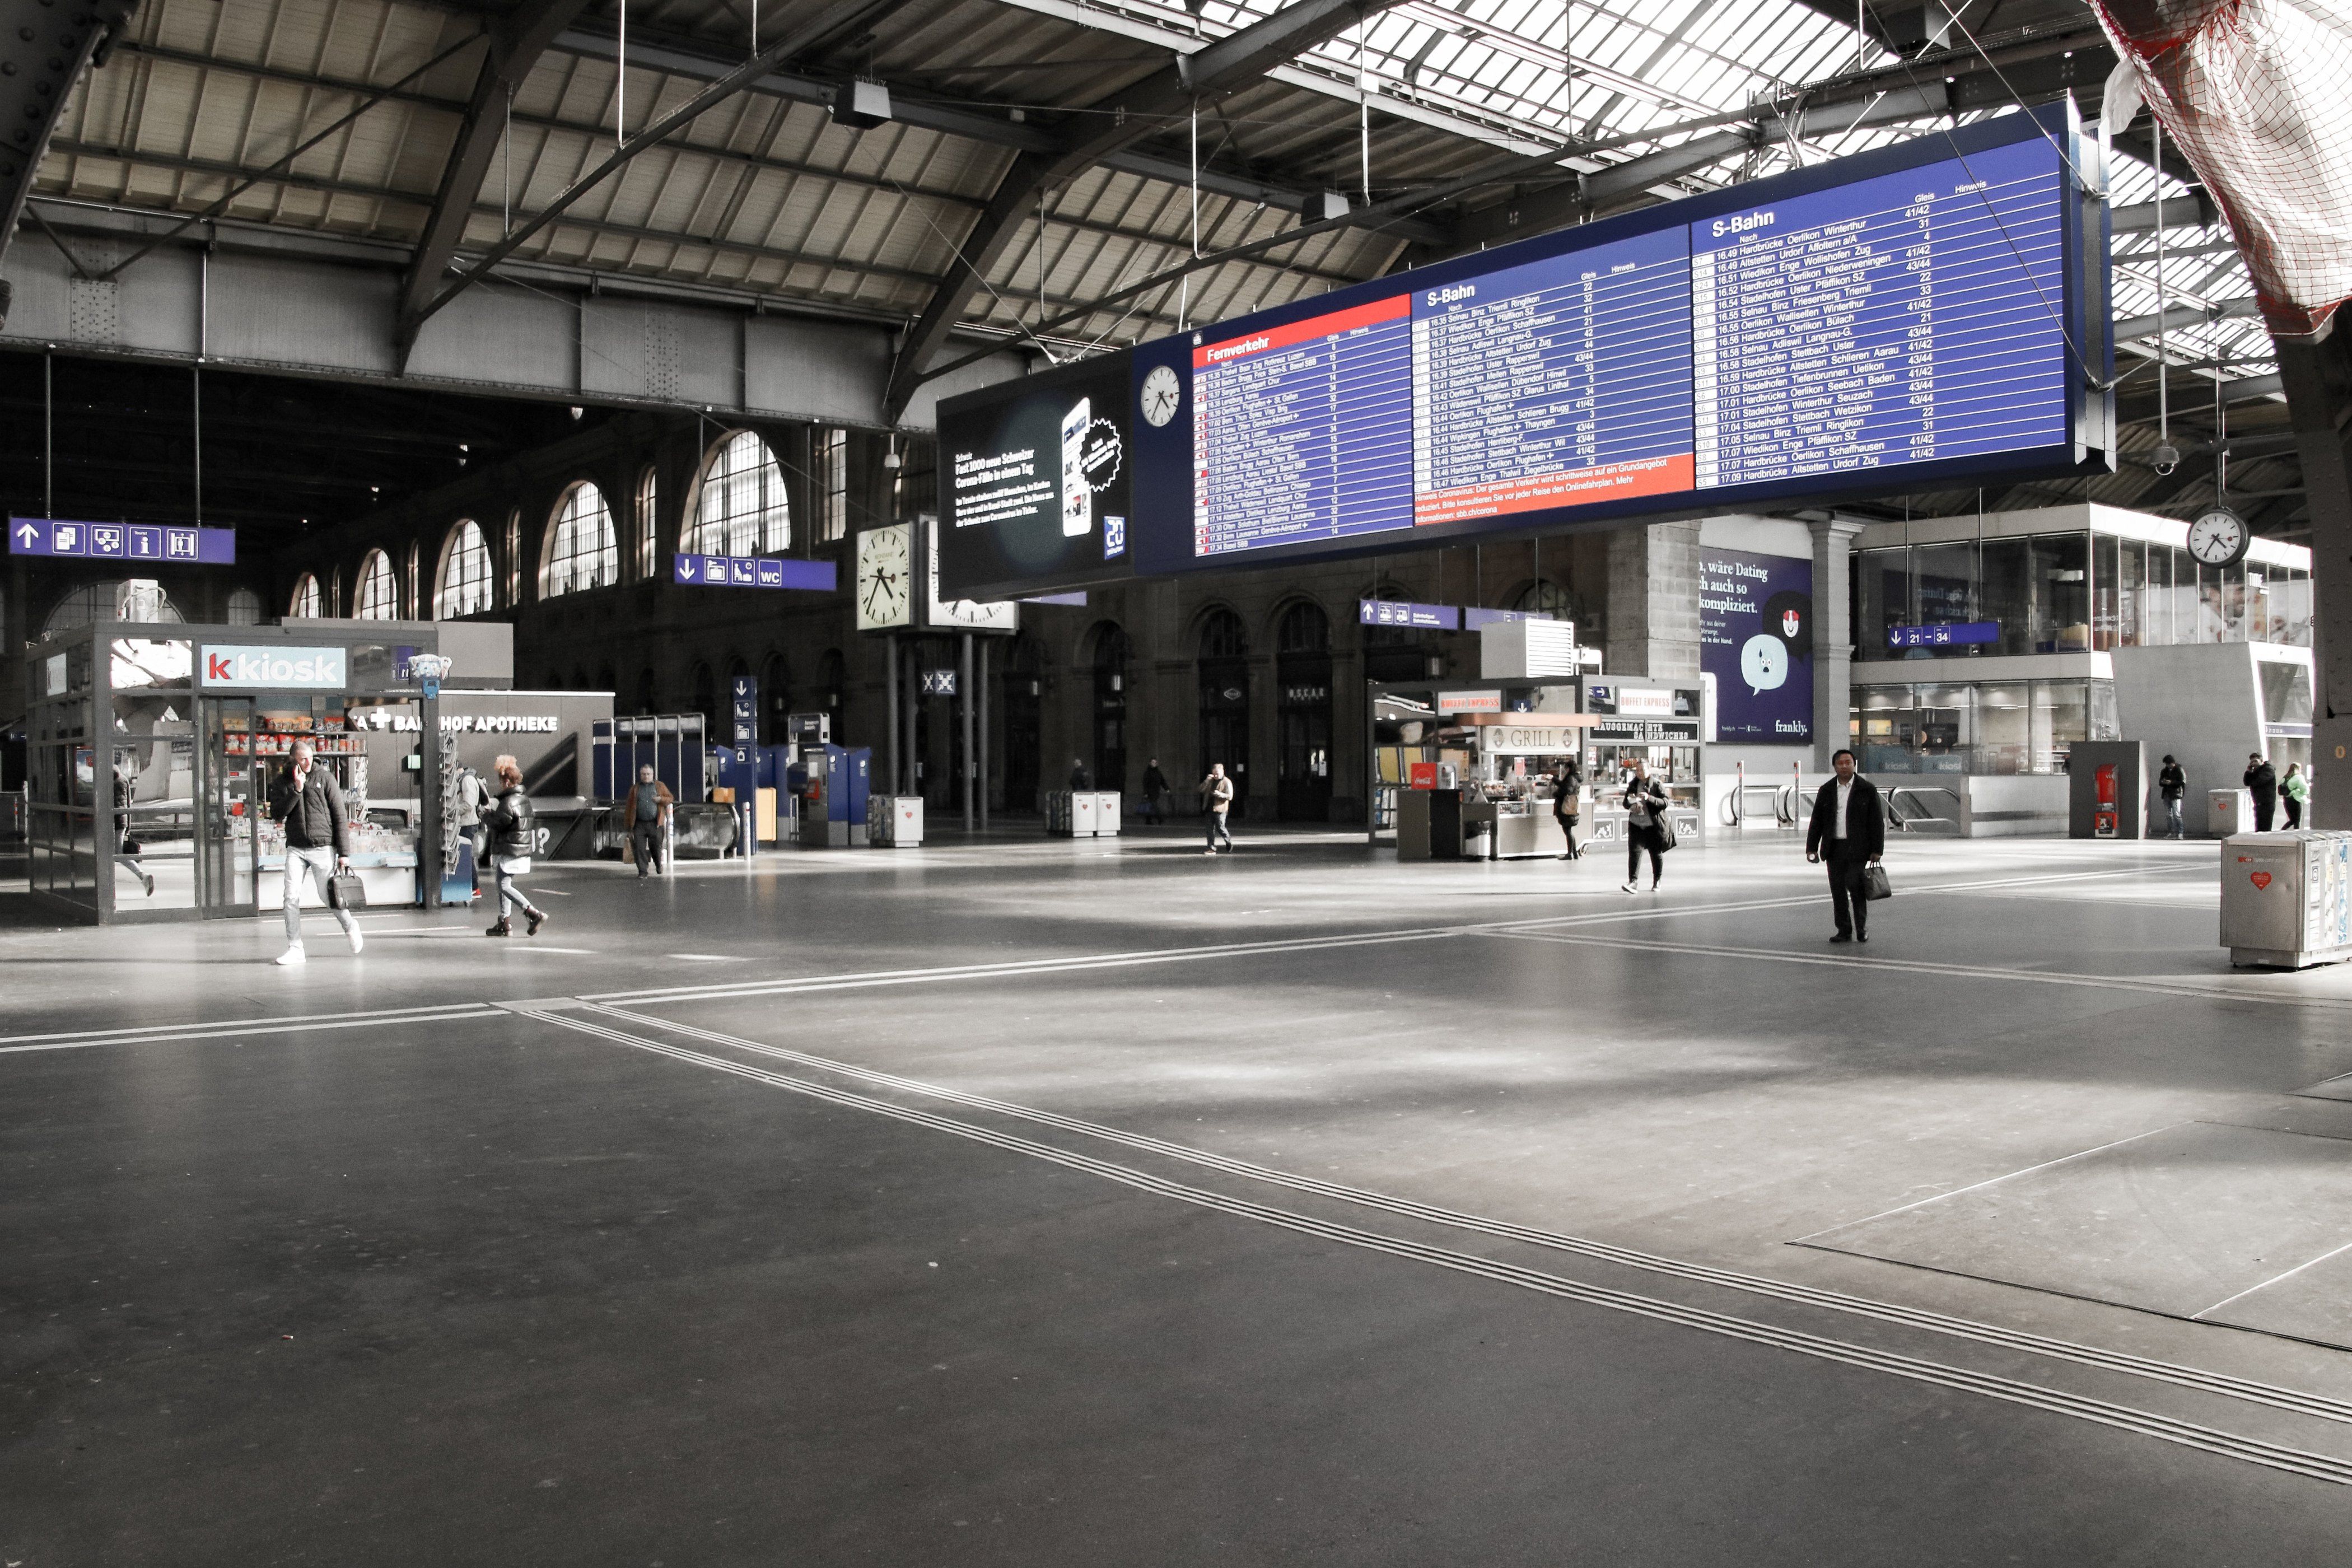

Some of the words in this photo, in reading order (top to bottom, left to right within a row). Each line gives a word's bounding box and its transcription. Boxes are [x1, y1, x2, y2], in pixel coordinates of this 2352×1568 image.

[1914, 192, 1935, 203] Gleis
[1954, 180, 1987, 194] Hinweis
[1712, 211, 1775, 237] S-Bahn
[1716, 248, 1738, 260] 16.49
[1739, 239, 1784, 255] Hardbrücke
[1787, 231, 1821, 245] Oerlikon
[1823, 220, 1866, 236] Winterthur
[1905, 204, 1930, 218] 41/42
[1717, 260, 1738, 273] 16.49
[1739, 254, 1775, 268] Altstetten
[1779, 245, 1804, 259] Urdorf
[1807, 239, 1841, 253] Affoltern
[1842, 234, 1858, 245] a/A
[1918, 218, 1929, 228] 31
[1739, 233, 1758, 244] Nach
[1717, 273, 1737, 285] 16.51
[1739, 267, 1776, 280] Wiedikon
[1779, 261, 1800, 272] Enge
[1803, 250, 1851, 267] Wollishofen
[1854, 245, 1871, 256] Zug
[1923, 231, 1931, 240] 4
[1580, 271, 1597, 281] Gleis
[1611, 262, 1635, 274] Hinweis
[1718, 285, 1738, 297] 16.52
[1740, 277, 1785, 293] Hardbrücke
[1788, 269, 1821, 283] Oerlikon
[1824, 254, 1892, 275] Niederweningen
[1905, 244, 1931, 258] 41/42
[1427, 284, 1475, 306] S-Bahn
[1718, 297, 1739, 310] 16.54
[1740, 289, 1786, 305] Stadelhofen
[1790, 284, 1812, 295] Uster
[1815, 276, 1851, 290] Pfäffikon
[1852, 271, 1865, 282] SZ
[1906, 258, 1931, 271] 43/44
[1430, 316, 1447, 327] 16.35
[1448, 312, 1469, 323] Selnau
[1471, 308, 1485, 318] Binz
[1487, 302, 1508, 313] Triemli
[1510, 295, 1540, 308] Ringlikon
[1583, 282, 1593, 292] 22
[1448, 303, 1462, 312] Nach
[1718, 310, 1739, 322] 16.55
[1740, 306, 1768, 318] Selnau
[1771, 301, 1789, 311] Binz
[1793, 291, 1841, 307] Friesenberg
[1844, 283, 1872, 297] Triemli
[1919, 271, 1931, 282] 22
[1207, 337, 1270, 362] Fernverkehr
[955, 462, 969, 475] Fast
[969, 458, 986, 472] 1000
[985, 457, 1001, 468] neue
[1001, 449, 1034, 464] Schweizer
[955, 471, 993, 488] Corona-Fälle
[993, 469, 1001, 480] in
[1001, 466, 1021, 479] einem
[1020, 463, 1034, 475] Tag
[1415, 492, 1438, 502] Hinweis
[1438, 487, 1474, 498] Coronavirus:
[1487, 481, 1514, 493] gesamte
[1515, 477, 1540, 487] Verkehr
[1540, 474, 1554, 483] wird
[1555, 470, 1593, 481] schrittweise
[1594, 467, 1606, 476] auf
[1618, 459, 1667, 472] Grundangebot
[1415, 502, 1441, 512] reduziert.
[1442, 500, 1455, 509] Bitte
[1456, 496, 1492, 506] konsultieren
[1492, 493, 1504, 502] Sie
[1515, 489, 1532, 500] jeder
[1532, 487, 1551, 496] Reise
[1551, 485, 1564, 493] den
[1565, 478, 1614, 492] Onlinefahrplan.
[1616, 475, 1634, 484] Mehr
[1415, 512, 1455, 523] Informationen:
[1456, 506, 1497, 518] sbb.ch/corona
[761, 571, 780, 584] WC
[1708, 561, 1734, 575] wäre
[1736, 562, 1768, 583] Dating
[1710, 578, 1734, 594] auch
[1737, 585, 1747, 595] so
[1699, 593, 1758, 614] kompliziert.
[1910, 634, 1919, 643] 21
[1936, 633, 1948, 642] 34
[238, 652, 337, 682] kiosk
[1441, 698, 1466, 708] BUFFET
[1468, 697, 1499, 708] EXPRESS
[1621, 696, 1642, 706] BUFFET
[1644, 697, 1670, 708] EXPRESS
[475, 716, 557, 731] APOTHEKE
[1775, 719, 1808, 736] frankly.
[1510, 729, 1556, 747] GRILL
[1634, 731, 1688, 740] SANDWICHES
